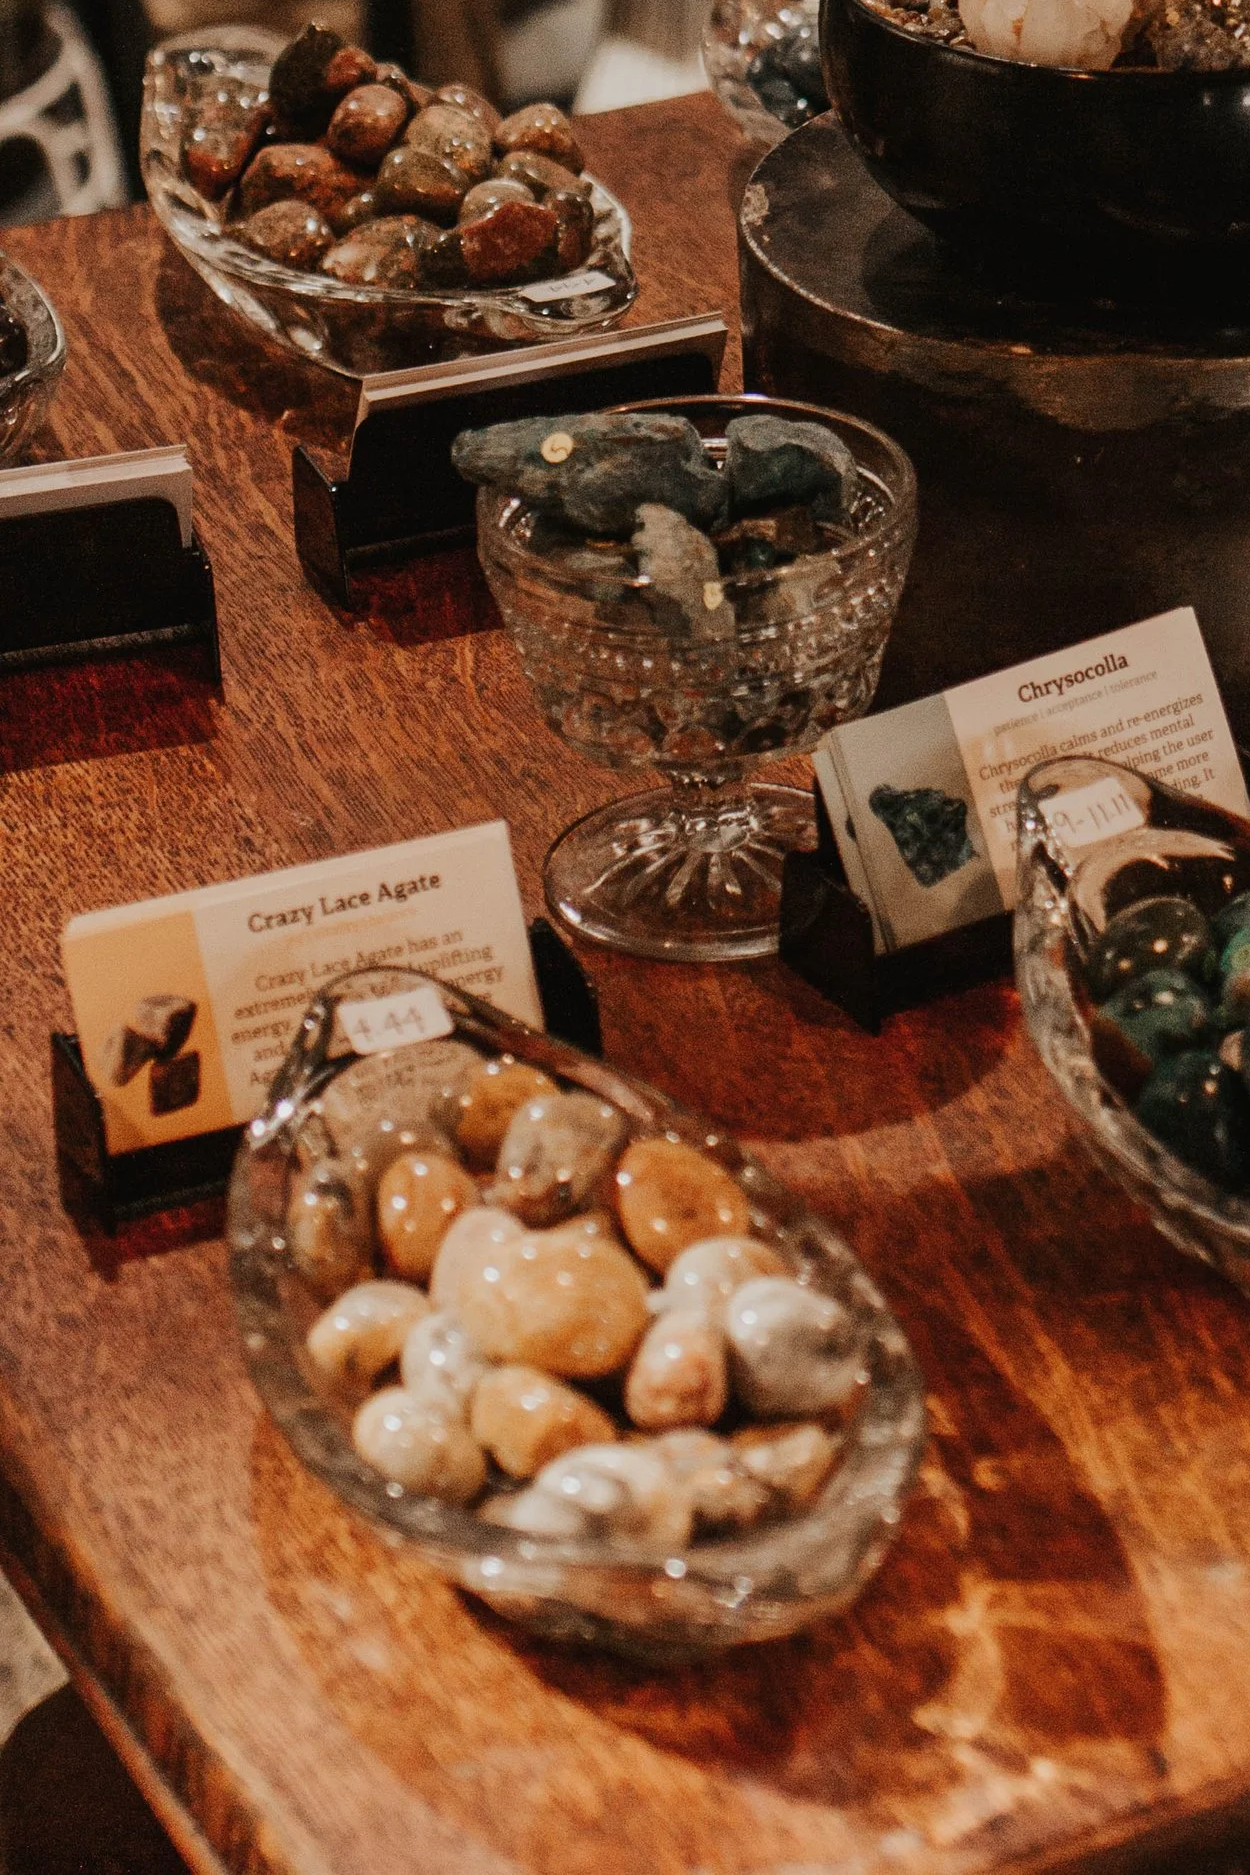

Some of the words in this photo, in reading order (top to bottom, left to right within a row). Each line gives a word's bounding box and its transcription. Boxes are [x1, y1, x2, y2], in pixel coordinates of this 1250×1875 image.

[1018, 653, 1129, 703] Chrysocolla
[993, 713, 1039, 737] patience
[1046, 688, 1103, 717] acceptance
[1109, 670, 1158, 695] tolerance
[979, 744, 1058, 781] Chrysocolla
[1059, 731, 1098, 755] calms
[1100, 719, 1125, 738] and
[1127, 692, 1204, 728] re-energizes
[1098, 732, 1148, 758] reduces
[1149, 713, 1196, 741] mental
[1162, 740, 1184, 757] the
[1186, 728, 1215, 747] user
[1176, 751, 1209, 771] more
[1203, 767, 1216, 782] It
[248, 904, 315, 933] Crazy
[319, 892, 372, 916] Lace
[377, 875, 441, 903] Agate
[255, 970, 305, 992] Crazy
[311, 959, 350, 978] Lace
[356, 945, 404, 970] Agate
[406, 936, 438, 954] has
[441, 930, 464, 945] an
